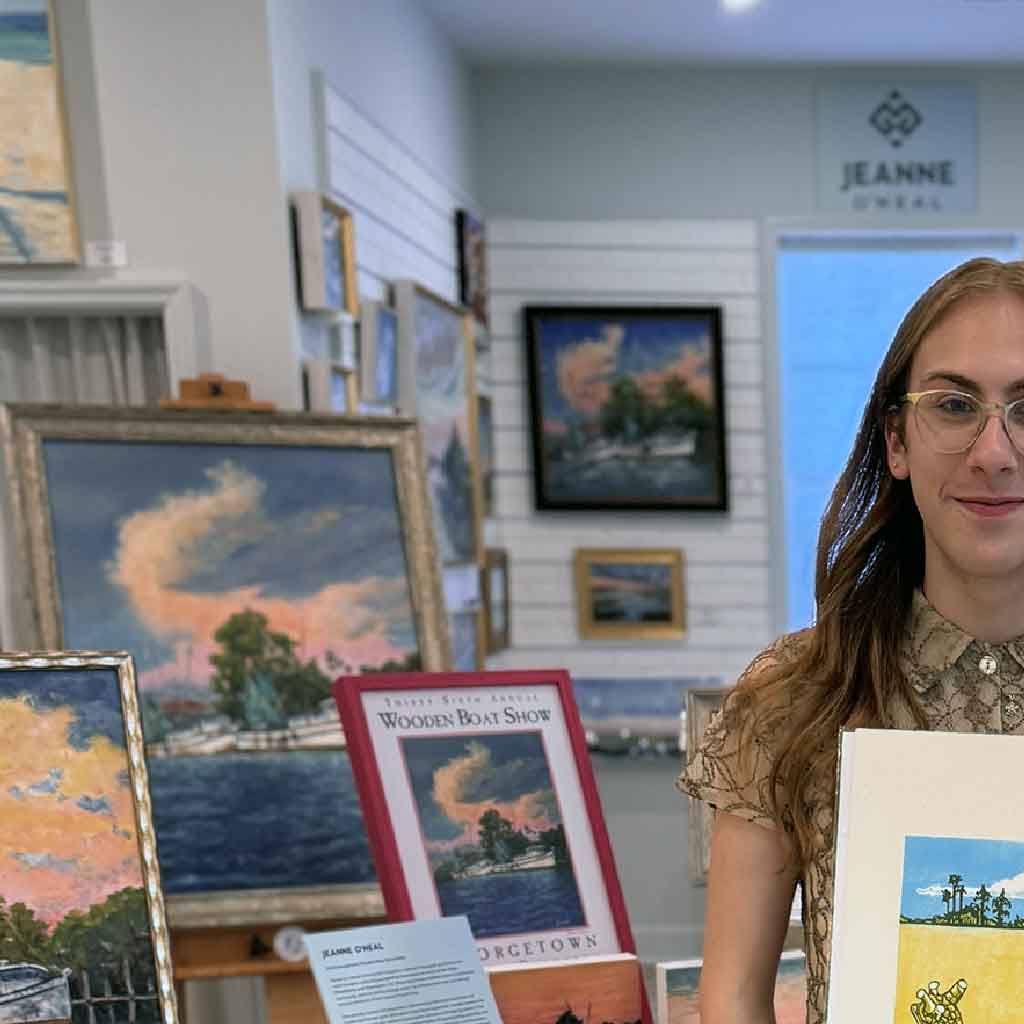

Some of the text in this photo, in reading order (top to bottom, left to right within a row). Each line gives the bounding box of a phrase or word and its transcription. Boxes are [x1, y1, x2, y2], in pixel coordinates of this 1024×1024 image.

[840, 160, 955, 194] JEANNE
[378, 706, 551, 729] WOODEN BOAT SHOW
